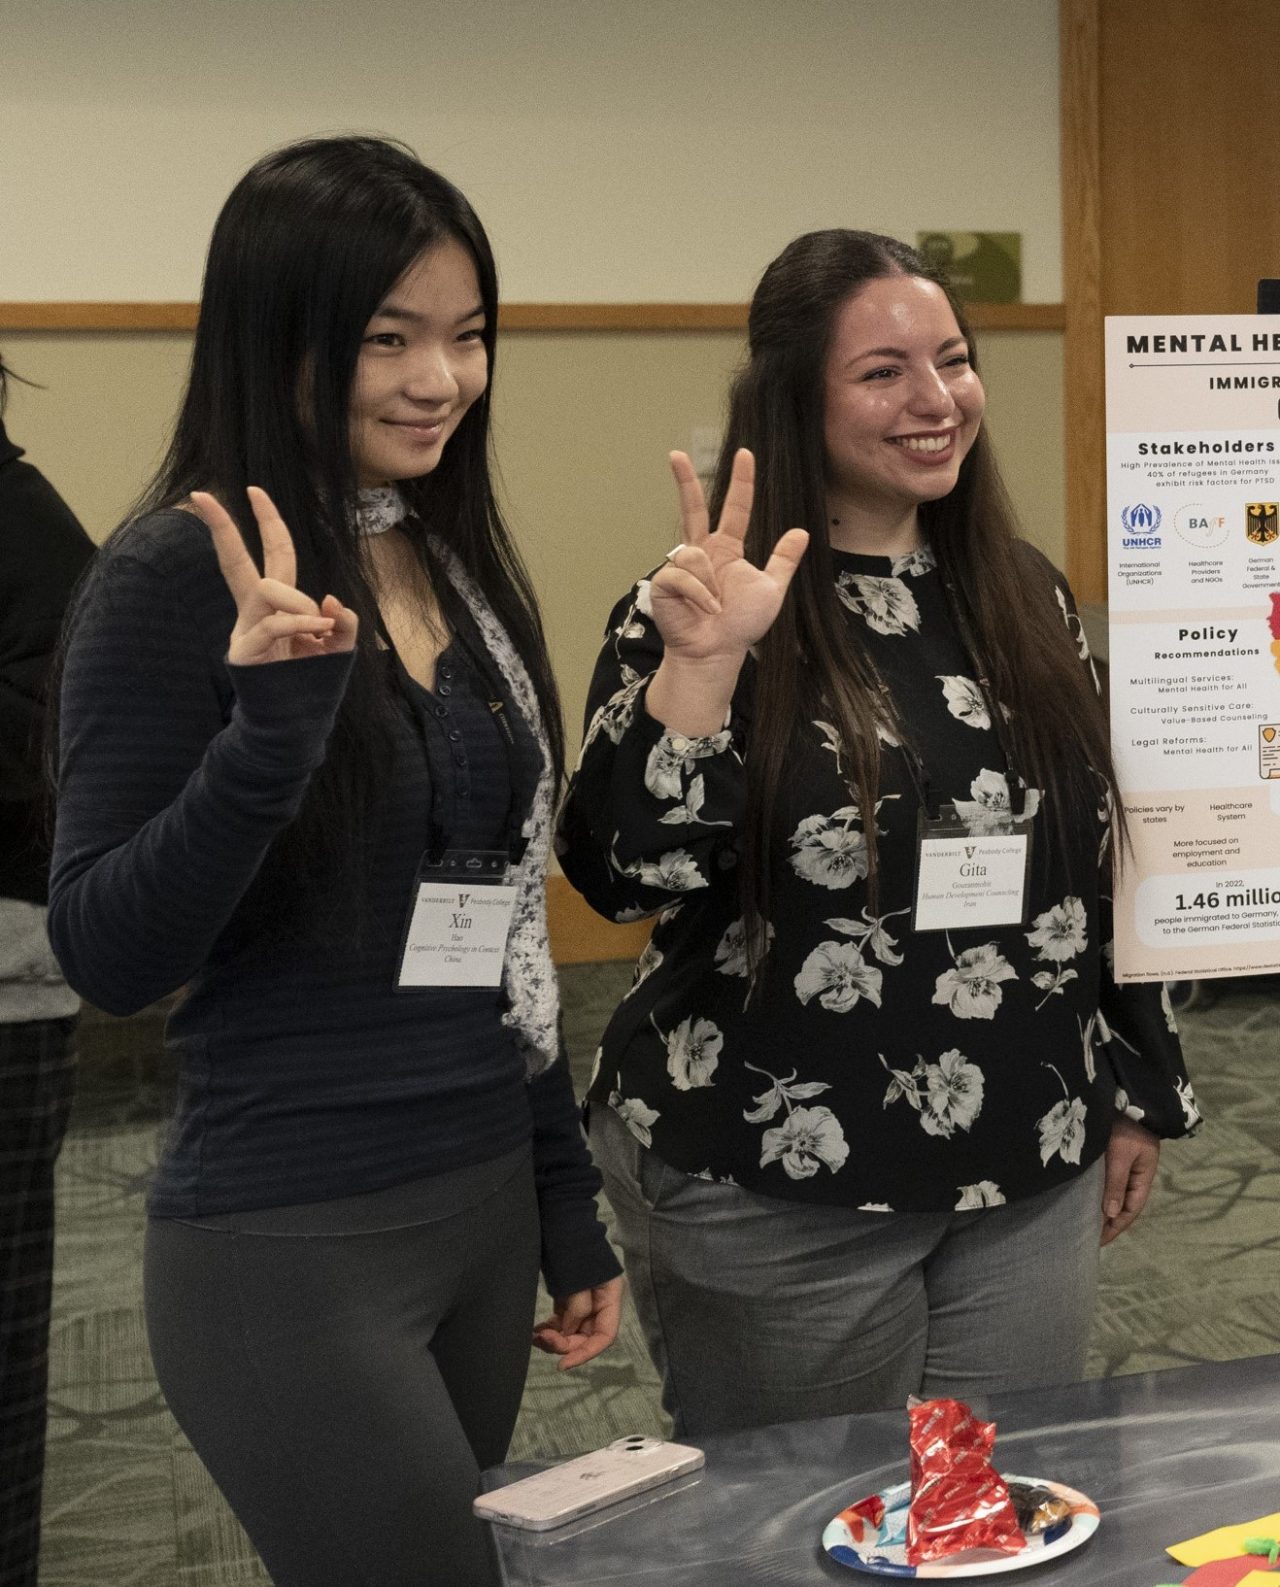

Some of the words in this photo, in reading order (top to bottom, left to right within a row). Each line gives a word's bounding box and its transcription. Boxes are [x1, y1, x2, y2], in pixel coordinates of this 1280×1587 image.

[1127, 334, 1242, 353] MENTAL
[1138, 440, 1274, 455] Stakeholders
[1121, 462, 1140, 470] High
[1239, 458, 1266, 466] Health
[1179, 470, 1216, 478] refugees
[1231, 468, 1268, 476] Germany
[1207, 478, 1237, 486] factors
[1122, 538, 1161, 546] UNHCR
[1178, 626, 1238, 642] Policy
[1155, 648, 1260, 660] Recommendations
[1130, 676, 1188, 686] Multilingual
[1192, 674, 1234, 683] Services:
[1130, 705, 1178, 715] Culturally
[1182, 704, 1225, 712] Sensitive
[1161, 715, 1217, 725] Value-Based
[1220, 713, 1268, 721] Counseling
[1132, 738, 1159, 748] Legal
[1163, 736, 1207, 745] Reforms:
[1163, 748, 1193, 756] Mental
[1196, 746, 1224, 754] Health
[1125, 805, 1153, 814] Policies
[1155, 805, 1173, 815] vary
[1175, 804, 1185, 812] by
[1210, 801, 1253, 811] Healthcare
[1143, 816, 1167, 824] states
[1217, 813, 1245, 822] System
[1174, 839, 1193, 847] More
[1195, 838, 1226, 846] focused
[1173, 848, 1223, 859] employment
[1225, 847, 1240, 855] and
[1187, 859, 1227, 868] education
[960, 863, 987, 877] Gita
[1225, 880, 1244, 888] 2022,
[1175, 892, 1219, 910] 1.46
[449, 914, 472, 929] Xin
[1154, 916, 1182, 926] people
[1184, 912, 1230, 924] immigrated
[1232, 912, 1239, 920] to
[1241, 909, 1278, 919] Germany,
[1173, 926, 1186, 934] the
[1188, 923, 1219, 933] German
[1222, 920, 1250, 930] Federal
